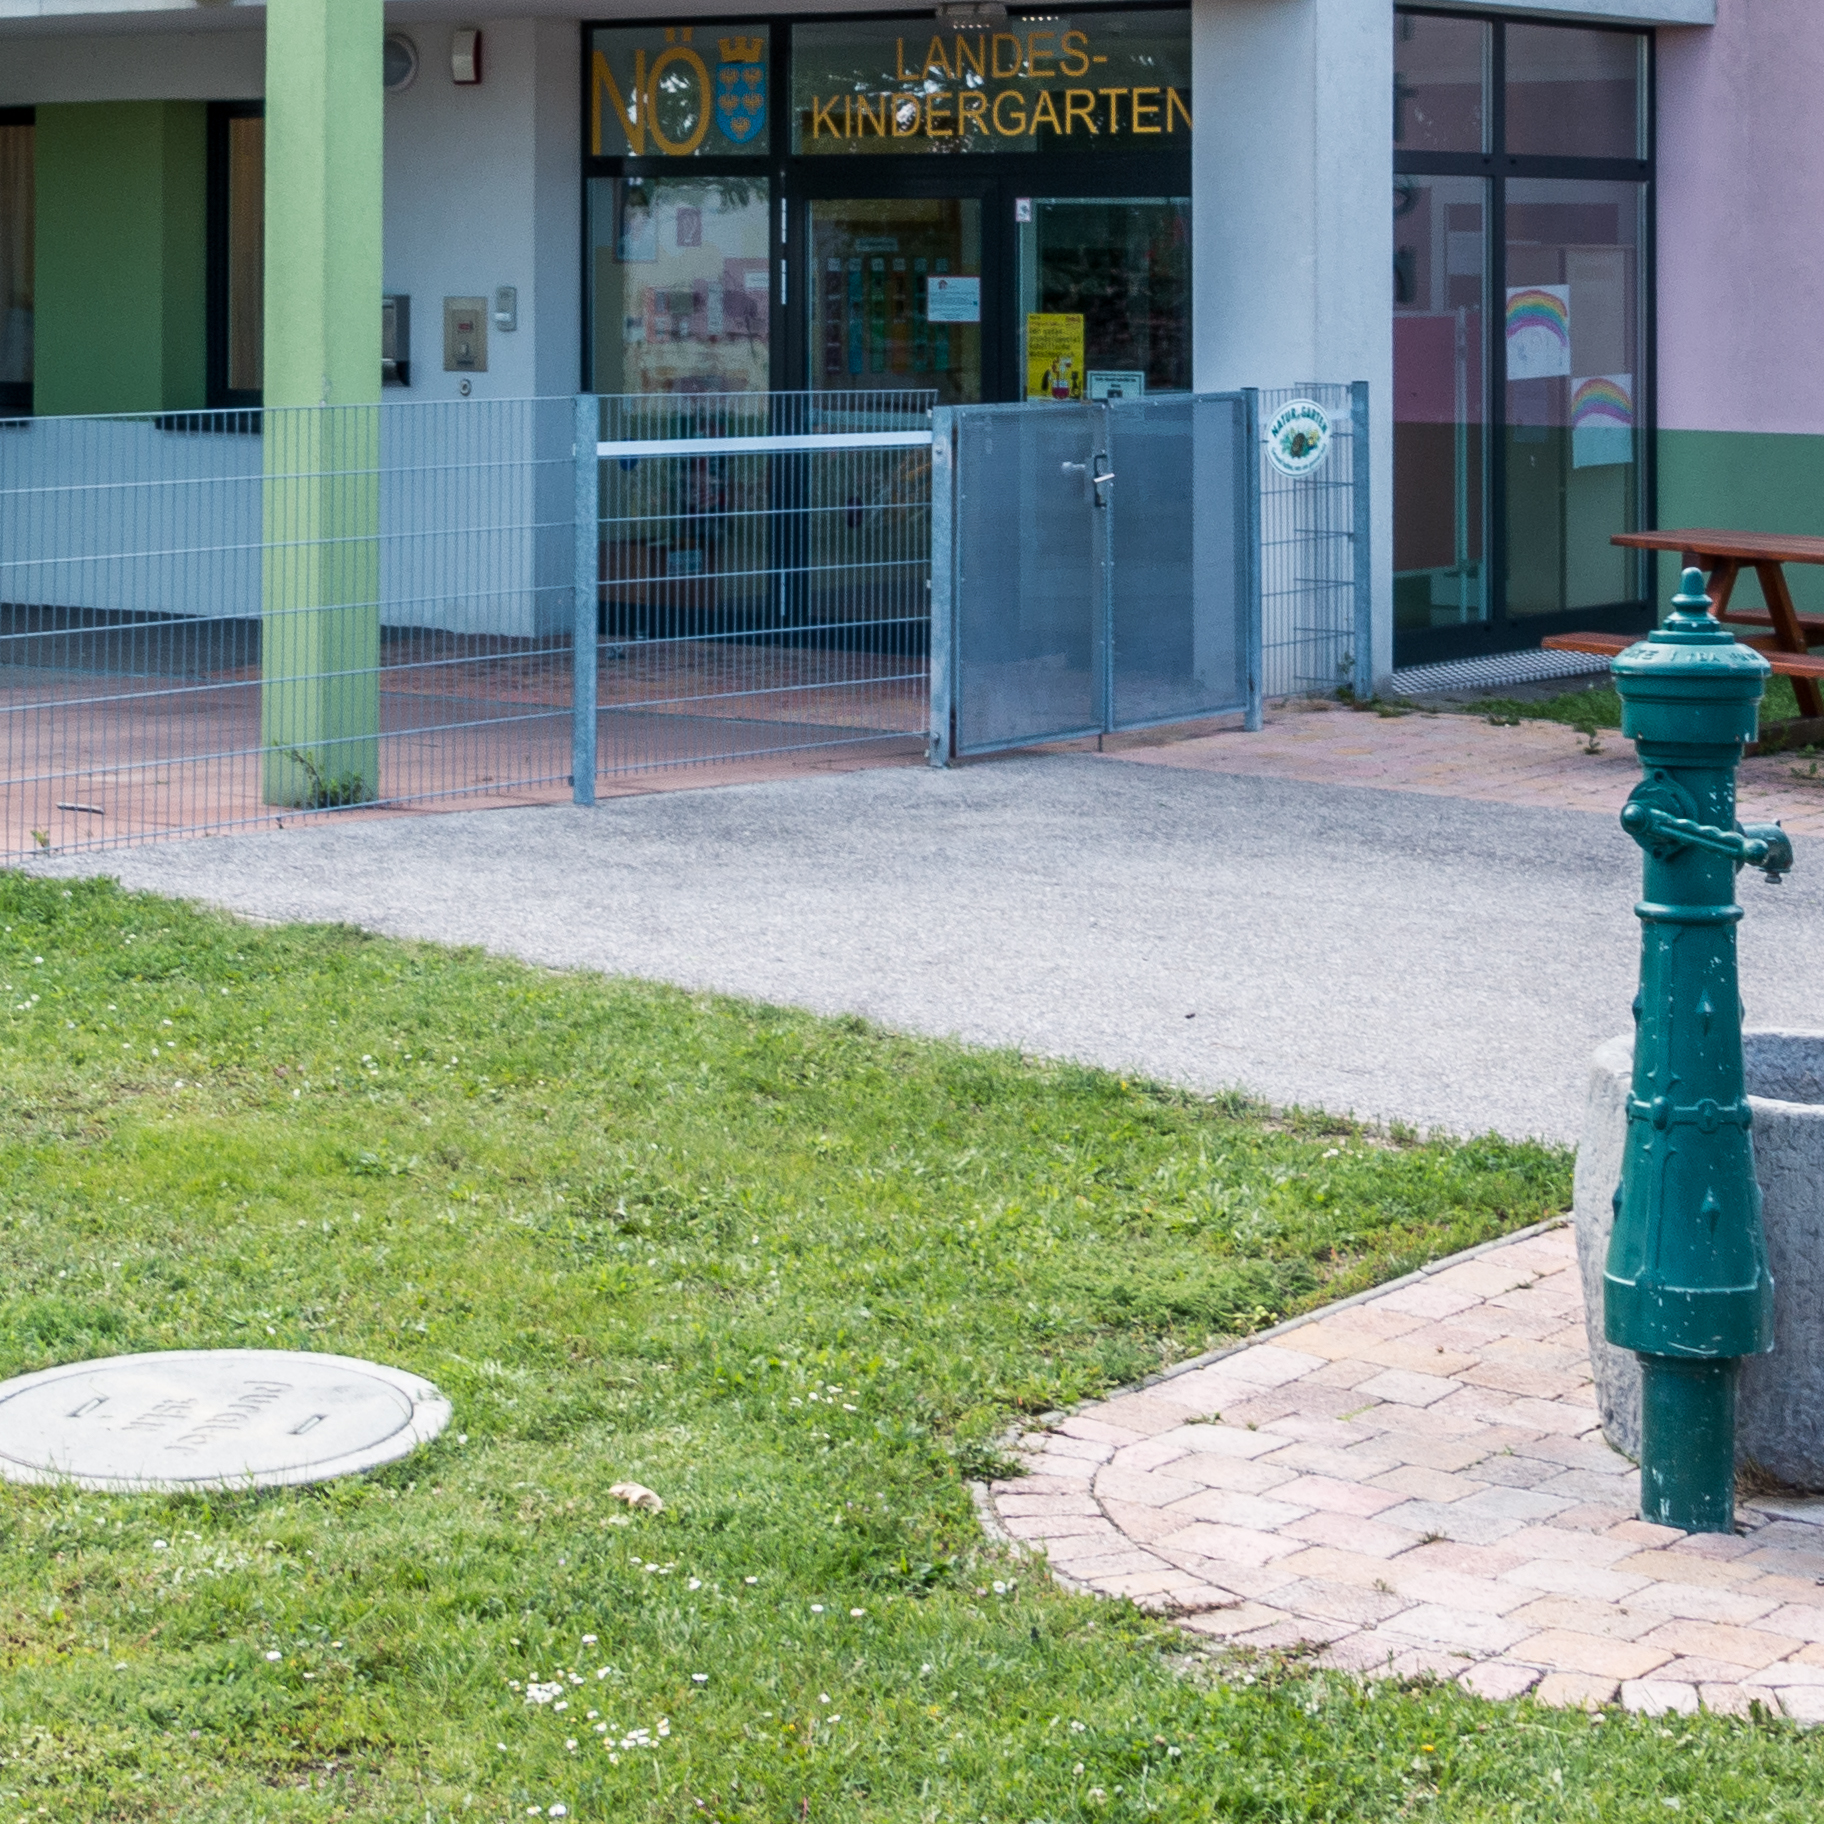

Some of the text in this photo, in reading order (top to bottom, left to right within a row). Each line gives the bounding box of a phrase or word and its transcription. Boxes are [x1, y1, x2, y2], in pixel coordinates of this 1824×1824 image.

[896, 30, 1109, 81] LANDES-
[591, 26, 712, 157] NÖ
[811, 85, 1193, 140] KINDERGARTEN
